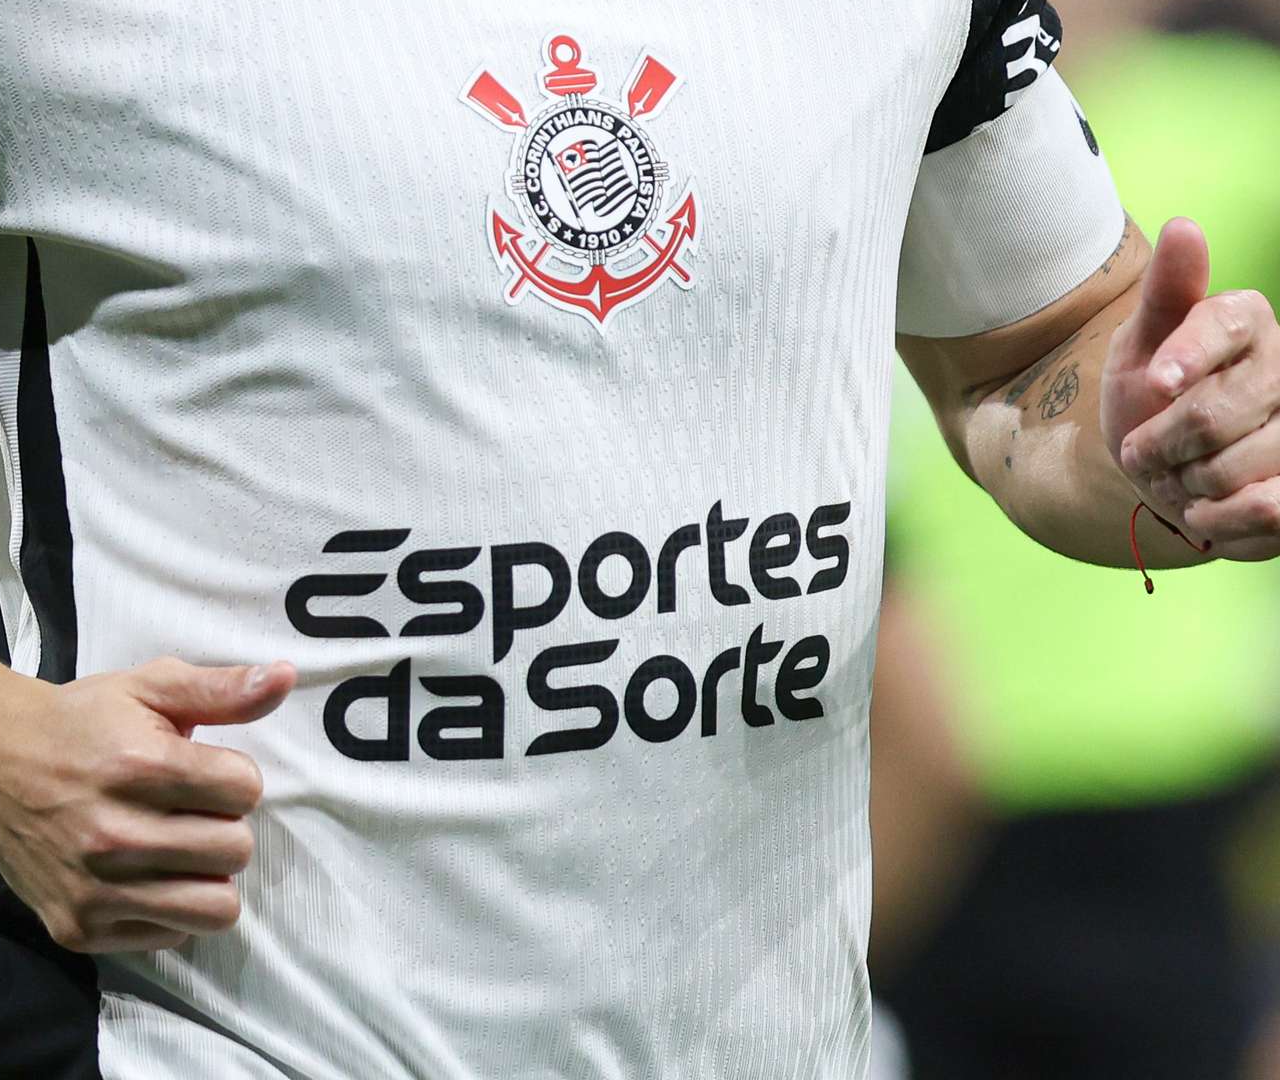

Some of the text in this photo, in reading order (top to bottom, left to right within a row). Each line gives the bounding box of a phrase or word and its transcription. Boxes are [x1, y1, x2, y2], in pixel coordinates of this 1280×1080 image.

[526, 109, 615, 192] CORINTHIANS
[616, 125, 654, 219] PAULISTA
[578, 228, 621, 249] 1910
[284, 499, 851, 664] Esportes
